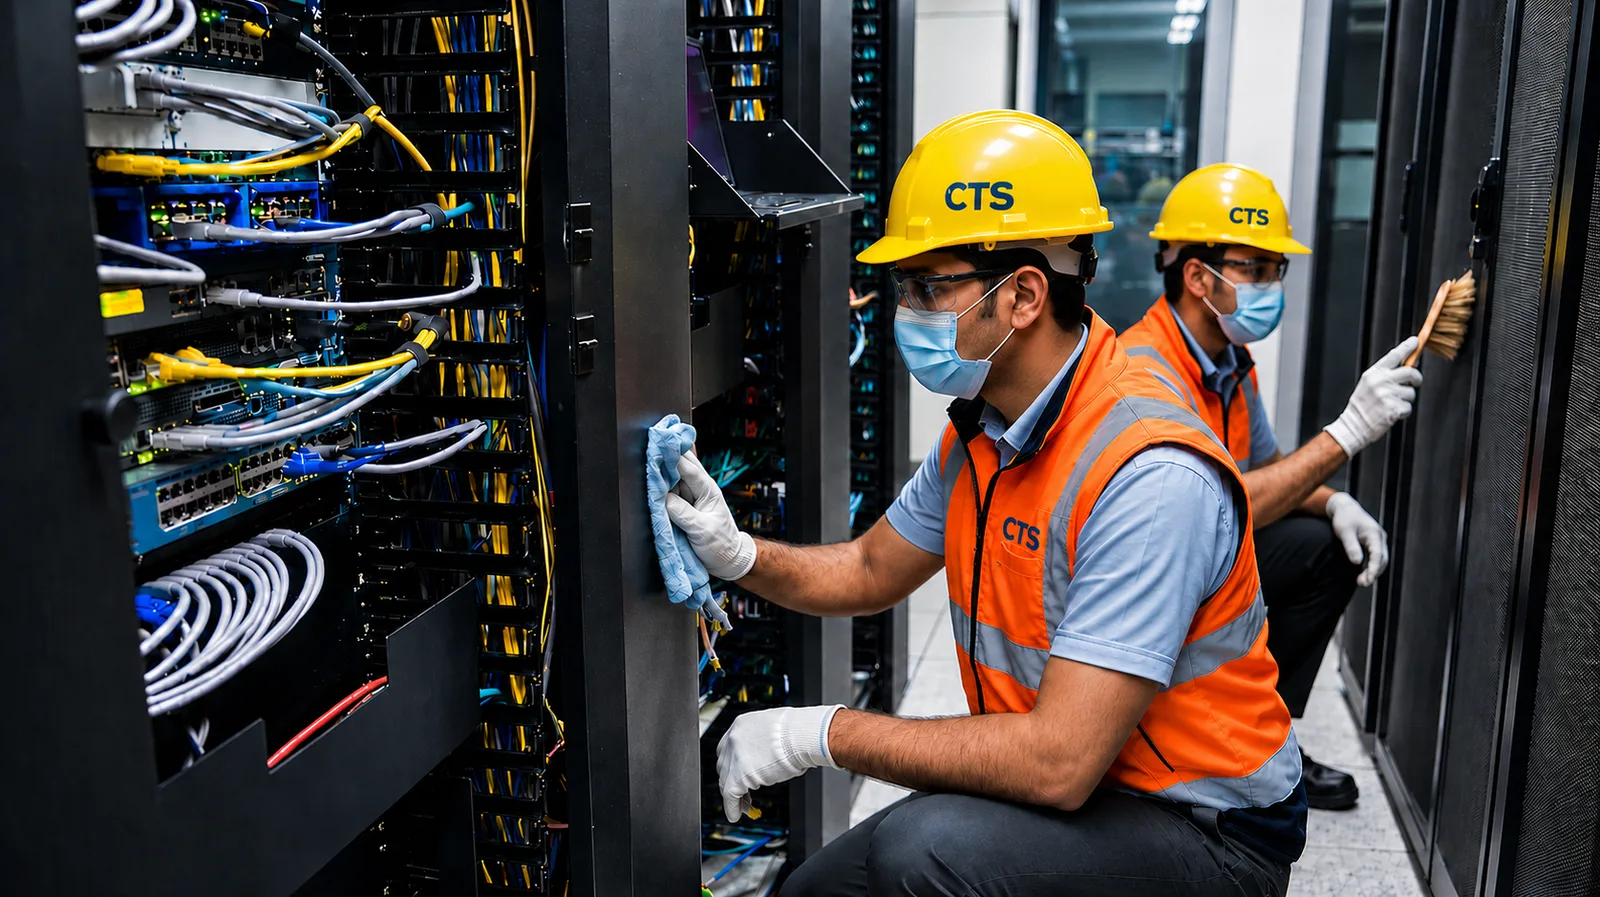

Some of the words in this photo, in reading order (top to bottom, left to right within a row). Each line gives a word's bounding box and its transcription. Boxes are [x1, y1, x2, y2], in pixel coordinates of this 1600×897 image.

[944, 181, 1015, 211] CTS
[1229, 207, 1269, 226] CTS
[1002, 516, 1041, 551] CTS
